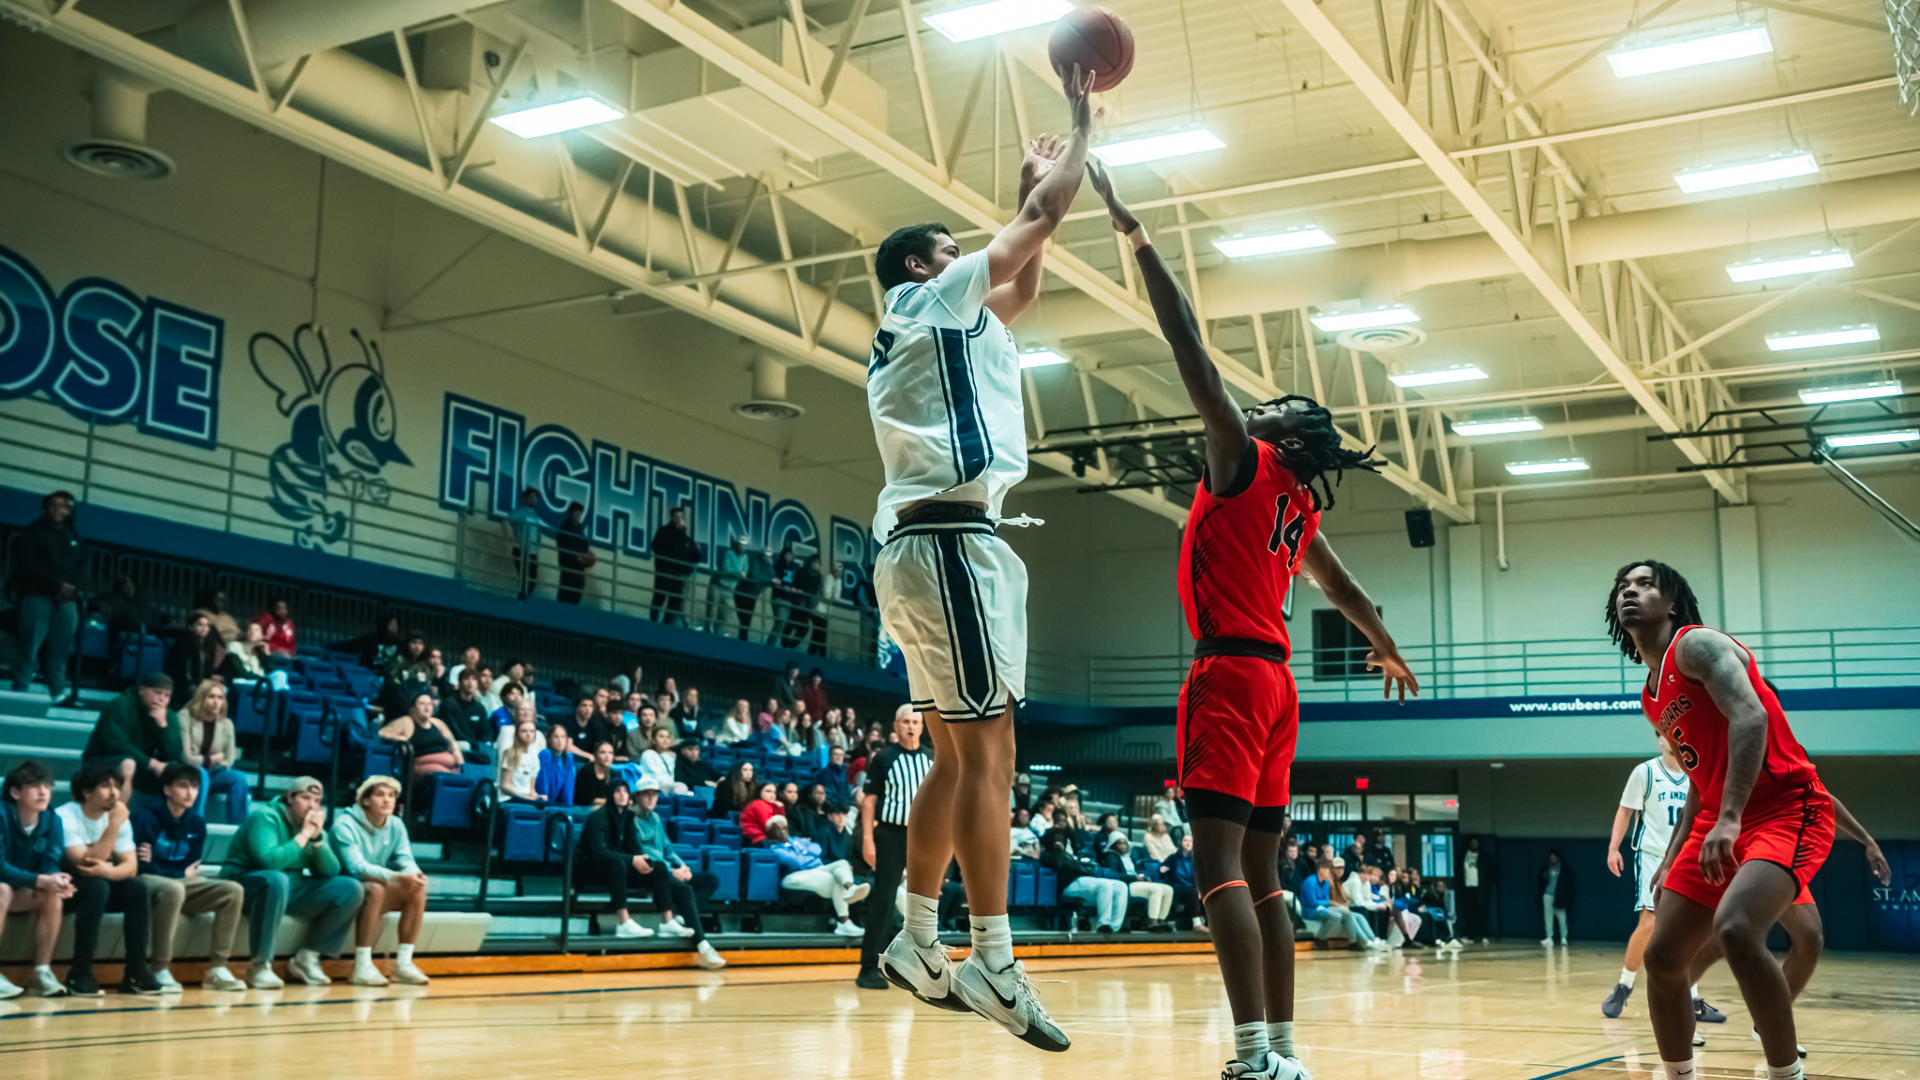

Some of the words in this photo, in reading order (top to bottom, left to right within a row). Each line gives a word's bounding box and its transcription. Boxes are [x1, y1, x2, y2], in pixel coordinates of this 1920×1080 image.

[440, 392, 821, 572] FIGHTING
[1267, 492, 1306, 570] 14
[1509, 698, 1642, 713] www.saubees.com
[1672, 726, 1700, 771] 5
